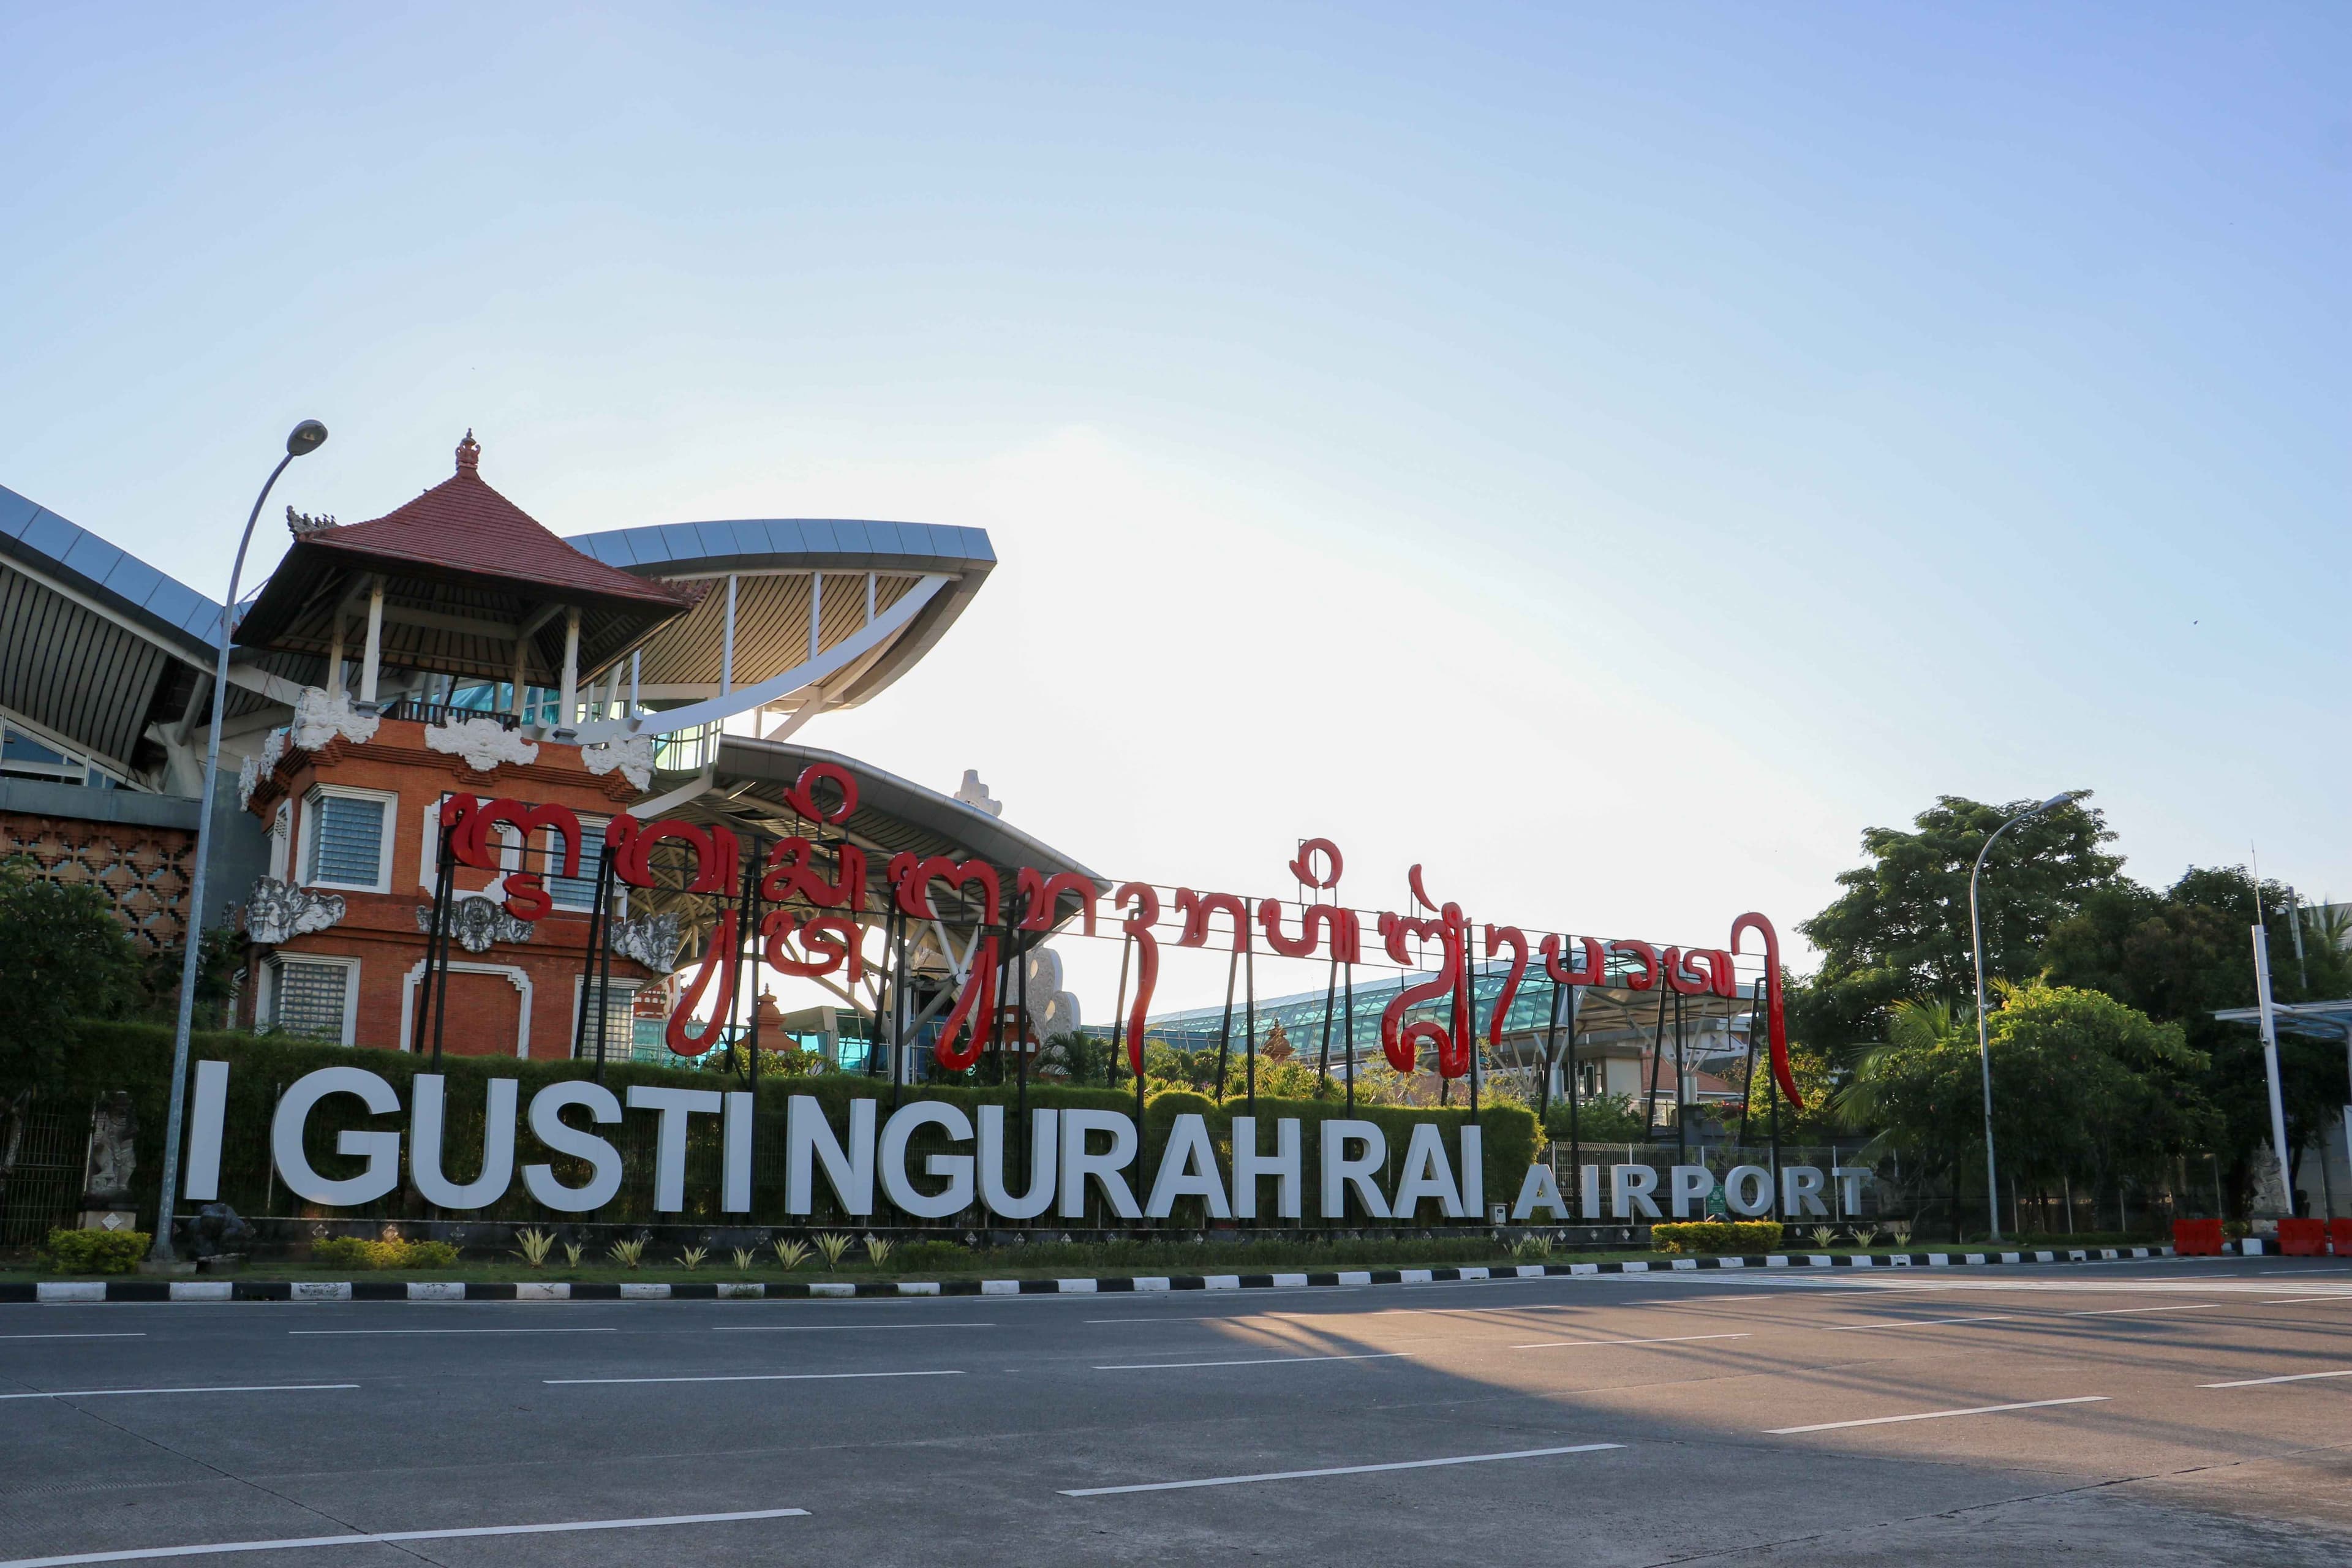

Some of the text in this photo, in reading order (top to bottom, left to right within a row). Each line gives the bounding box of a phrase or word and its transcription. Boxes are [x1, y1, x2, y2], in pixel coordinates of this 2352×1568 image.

[184, 1060, 229, 1200] I
[270, 1066, 753, 1212] GUSTI
[1512, 1164, 1871, 1219] AIRPORT
